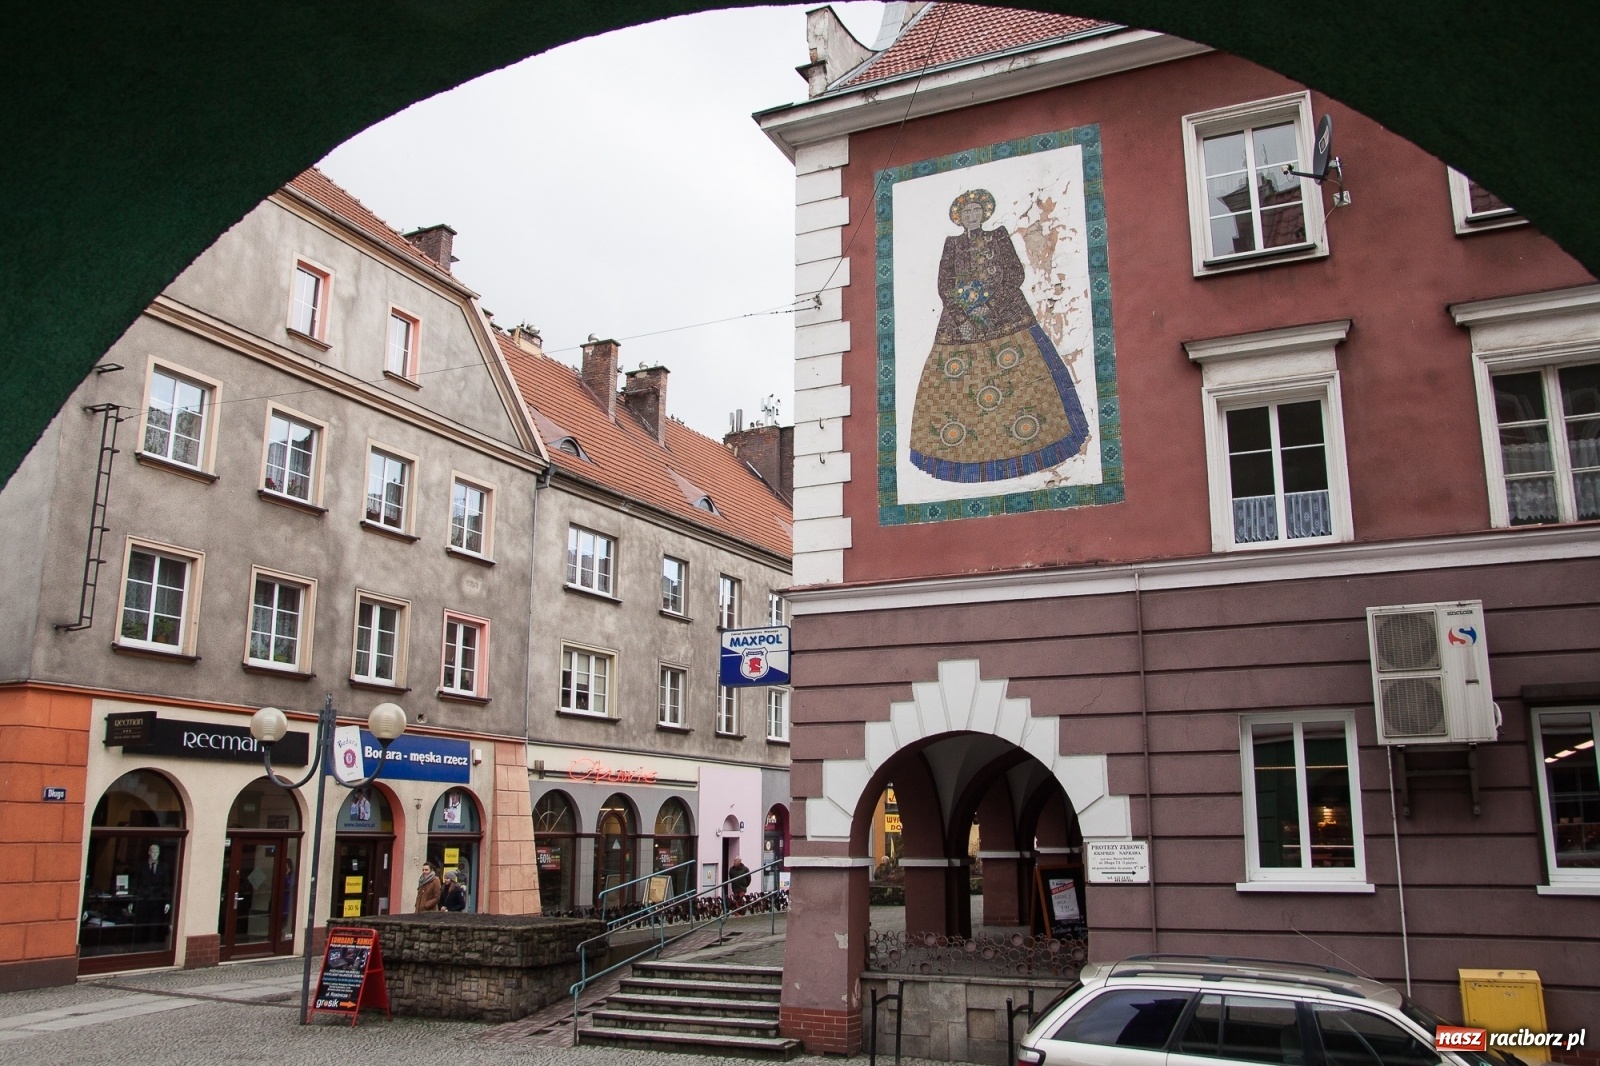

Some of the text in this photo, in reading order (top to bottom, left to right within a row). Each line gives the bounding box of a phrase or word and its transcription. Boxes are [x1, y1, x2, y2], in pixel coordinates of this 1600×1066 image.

[730, 634, 782, 647] MAXPOL
[410, 751, 441, 765] męska
[443, 756, 468, 766] rzecz
[316, 999, 339, 1008] grosik
